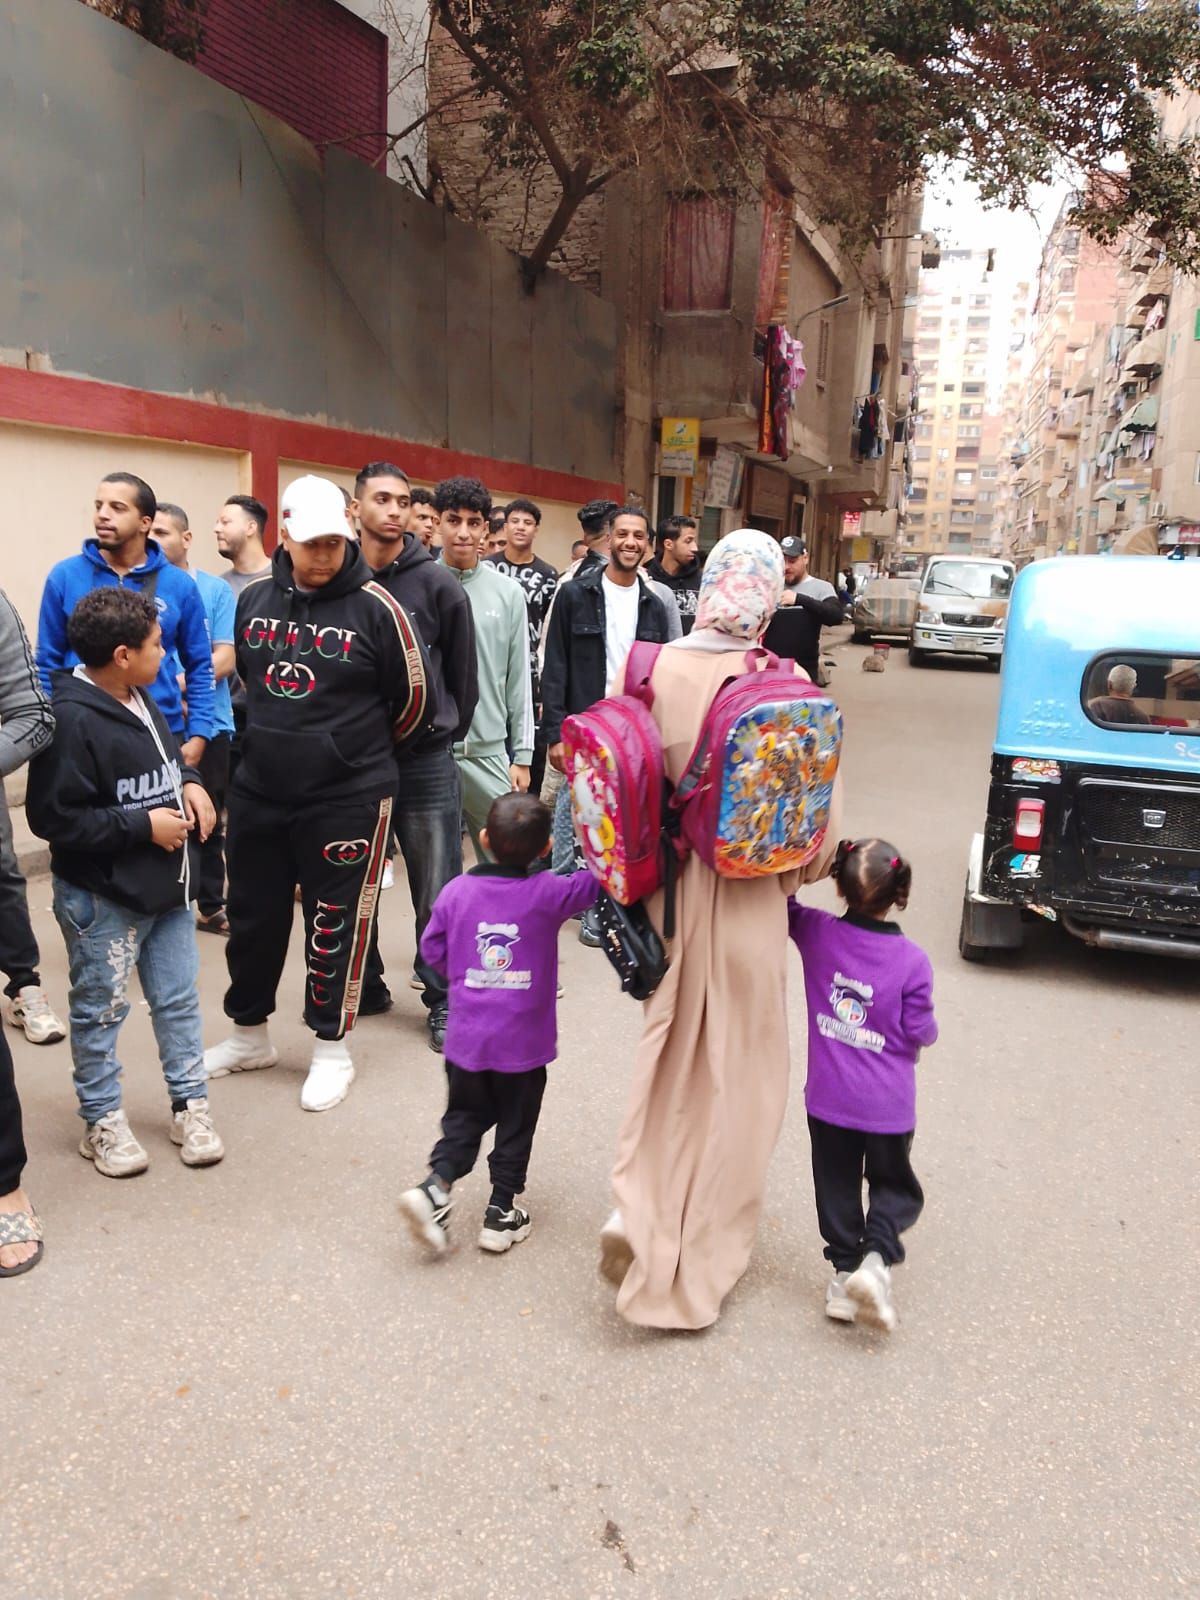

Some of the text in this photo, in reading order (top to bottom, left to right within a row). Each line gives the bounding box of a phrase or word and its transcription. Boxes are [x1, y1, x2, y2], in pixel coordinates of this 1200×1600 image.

[245, 618, 356, 662] GUCCI
[406, 650, 423, 686] GUCCI
[360, 884, 377, 918] GUCCI
[307, 899, 348, 1007] GUCCI
[345, 980, 360, 1012] GUCCI
